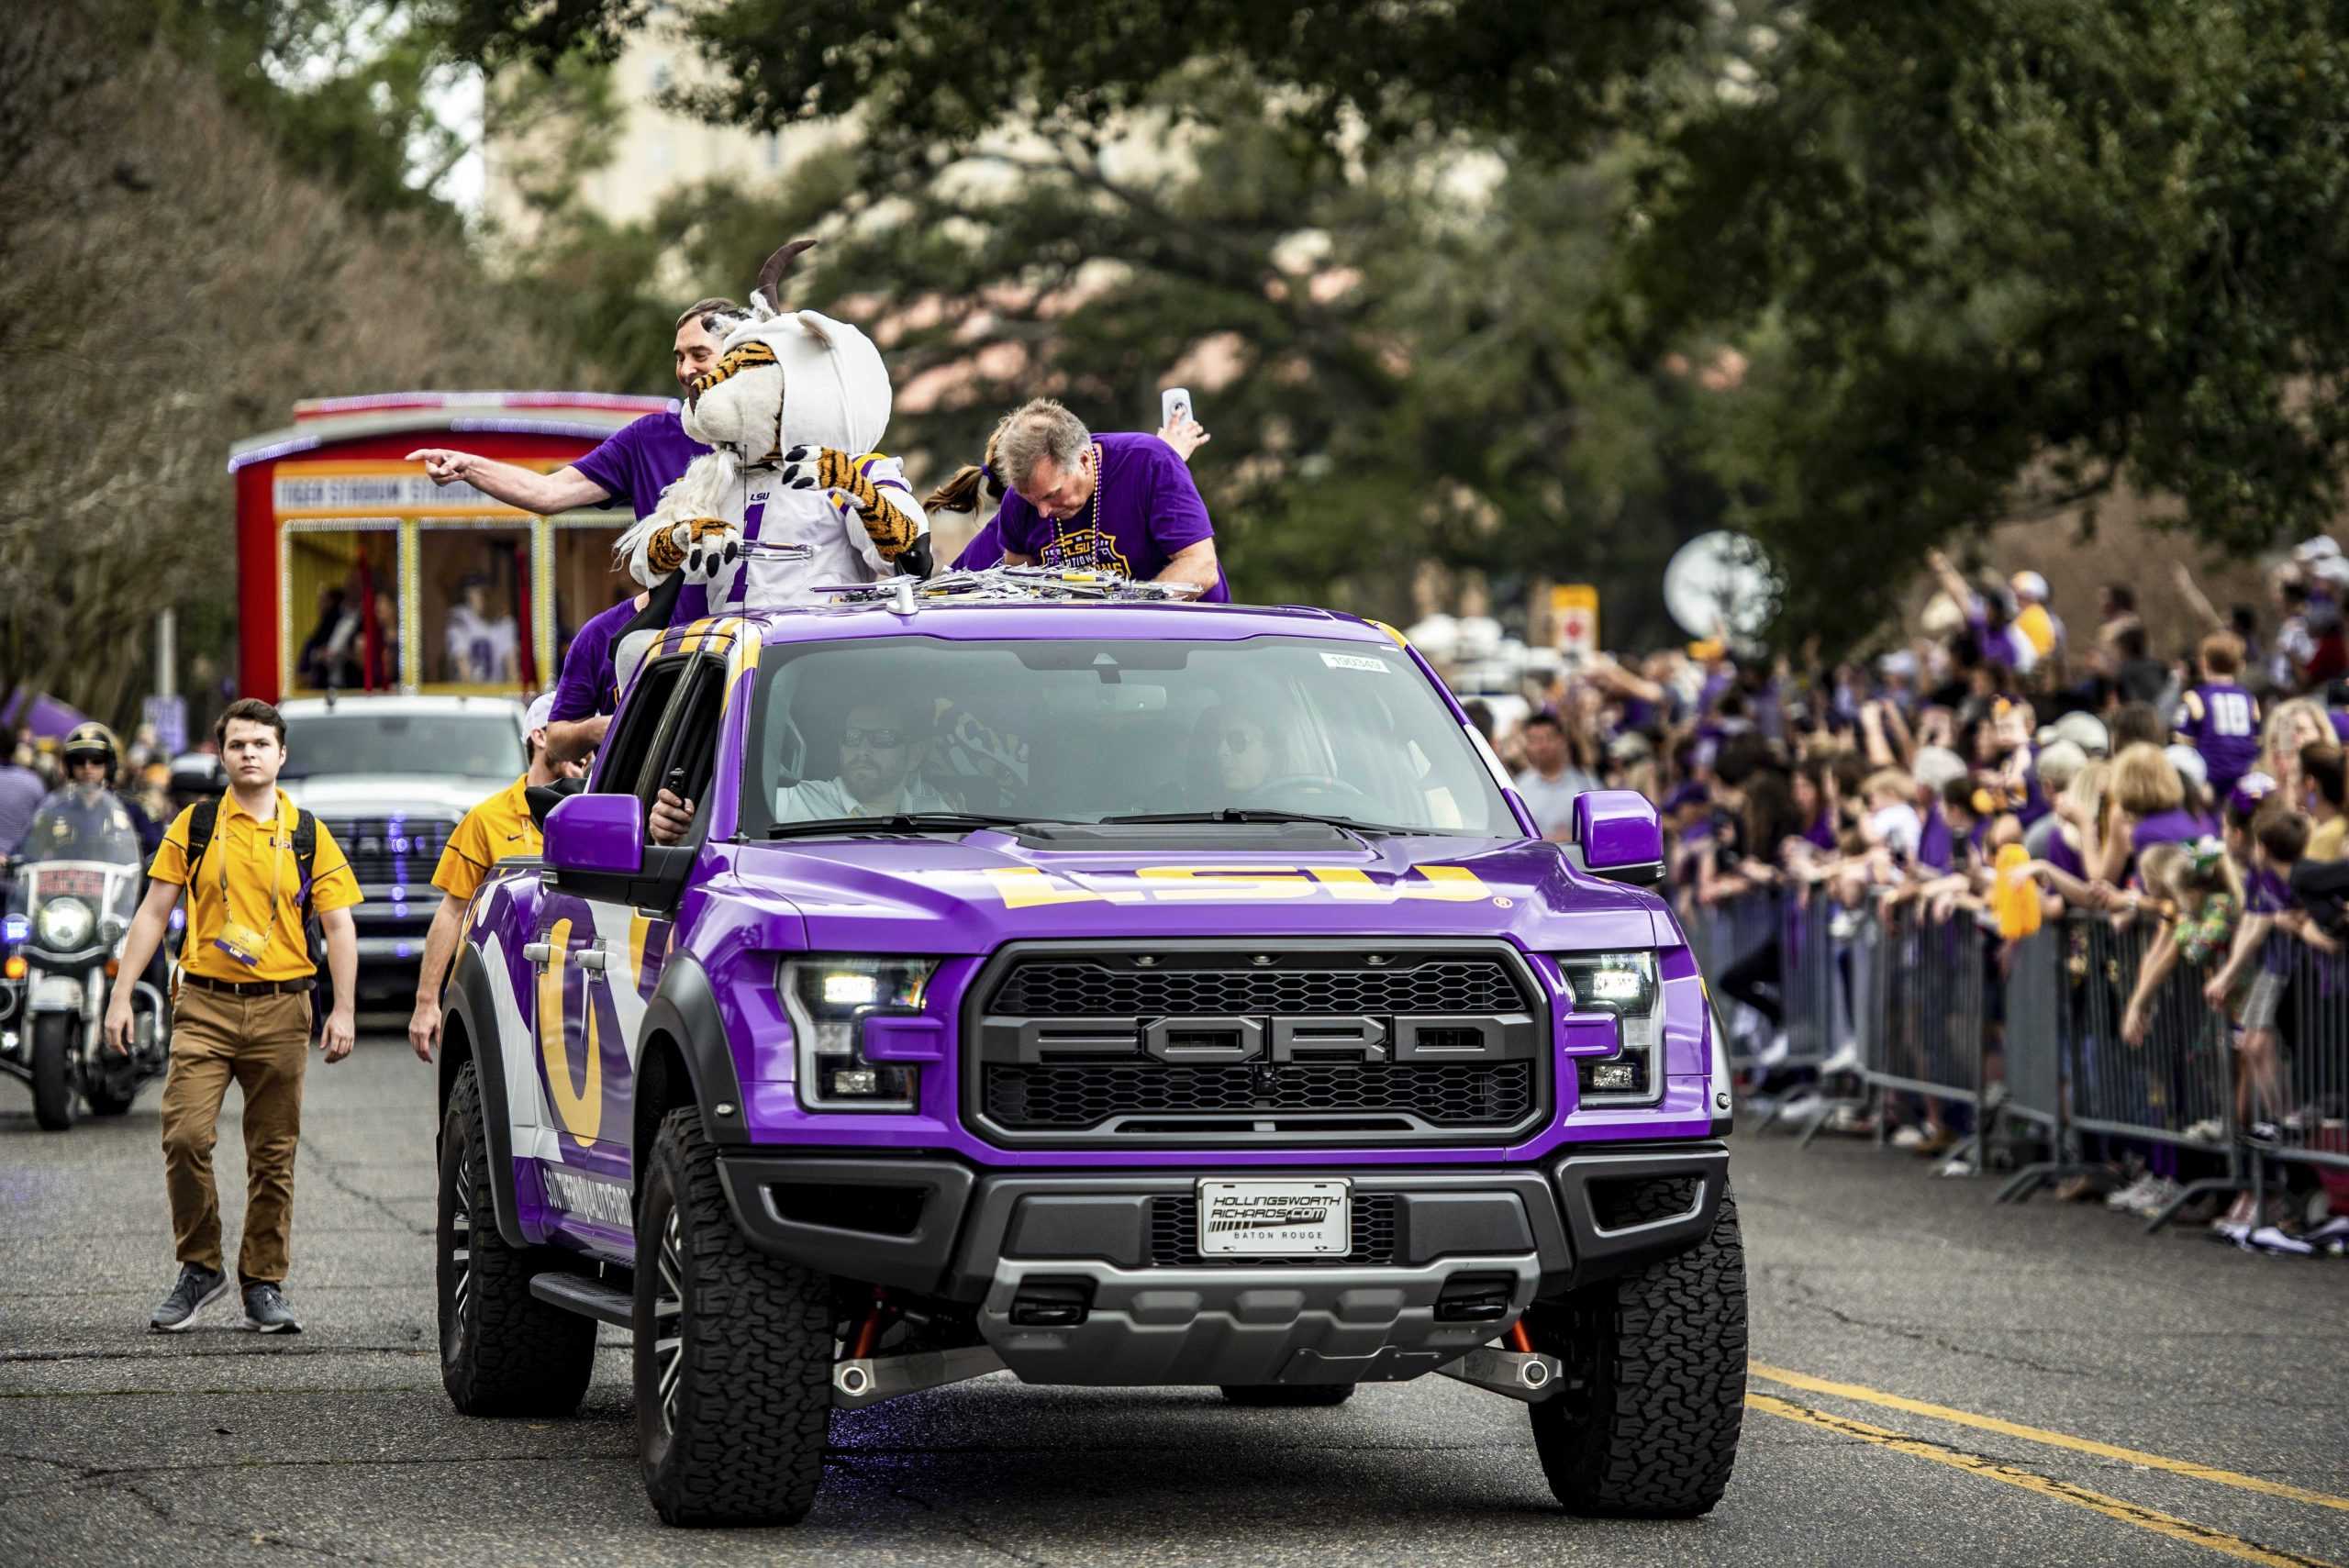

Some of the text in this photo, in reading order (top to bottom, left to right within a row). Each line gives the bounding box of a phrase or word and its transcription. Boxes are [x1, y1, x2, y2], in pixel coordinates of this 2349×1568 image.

[750, 492, 770, 501] LSU
[725, 502, 765, 604] 1
[1066, 541, 1091, 556] LSU
[982, 865, 1494, 909] LSU
[984, 1013, 1531, 1066] FORD
[543, 1167, 635, 1228] SOUTHERNQUALITYFORD
[1213, 1196, 1341, 1207] HOLLINGSWORTH
[1234, 1231, 1322, 1240] BATON ROUGE
